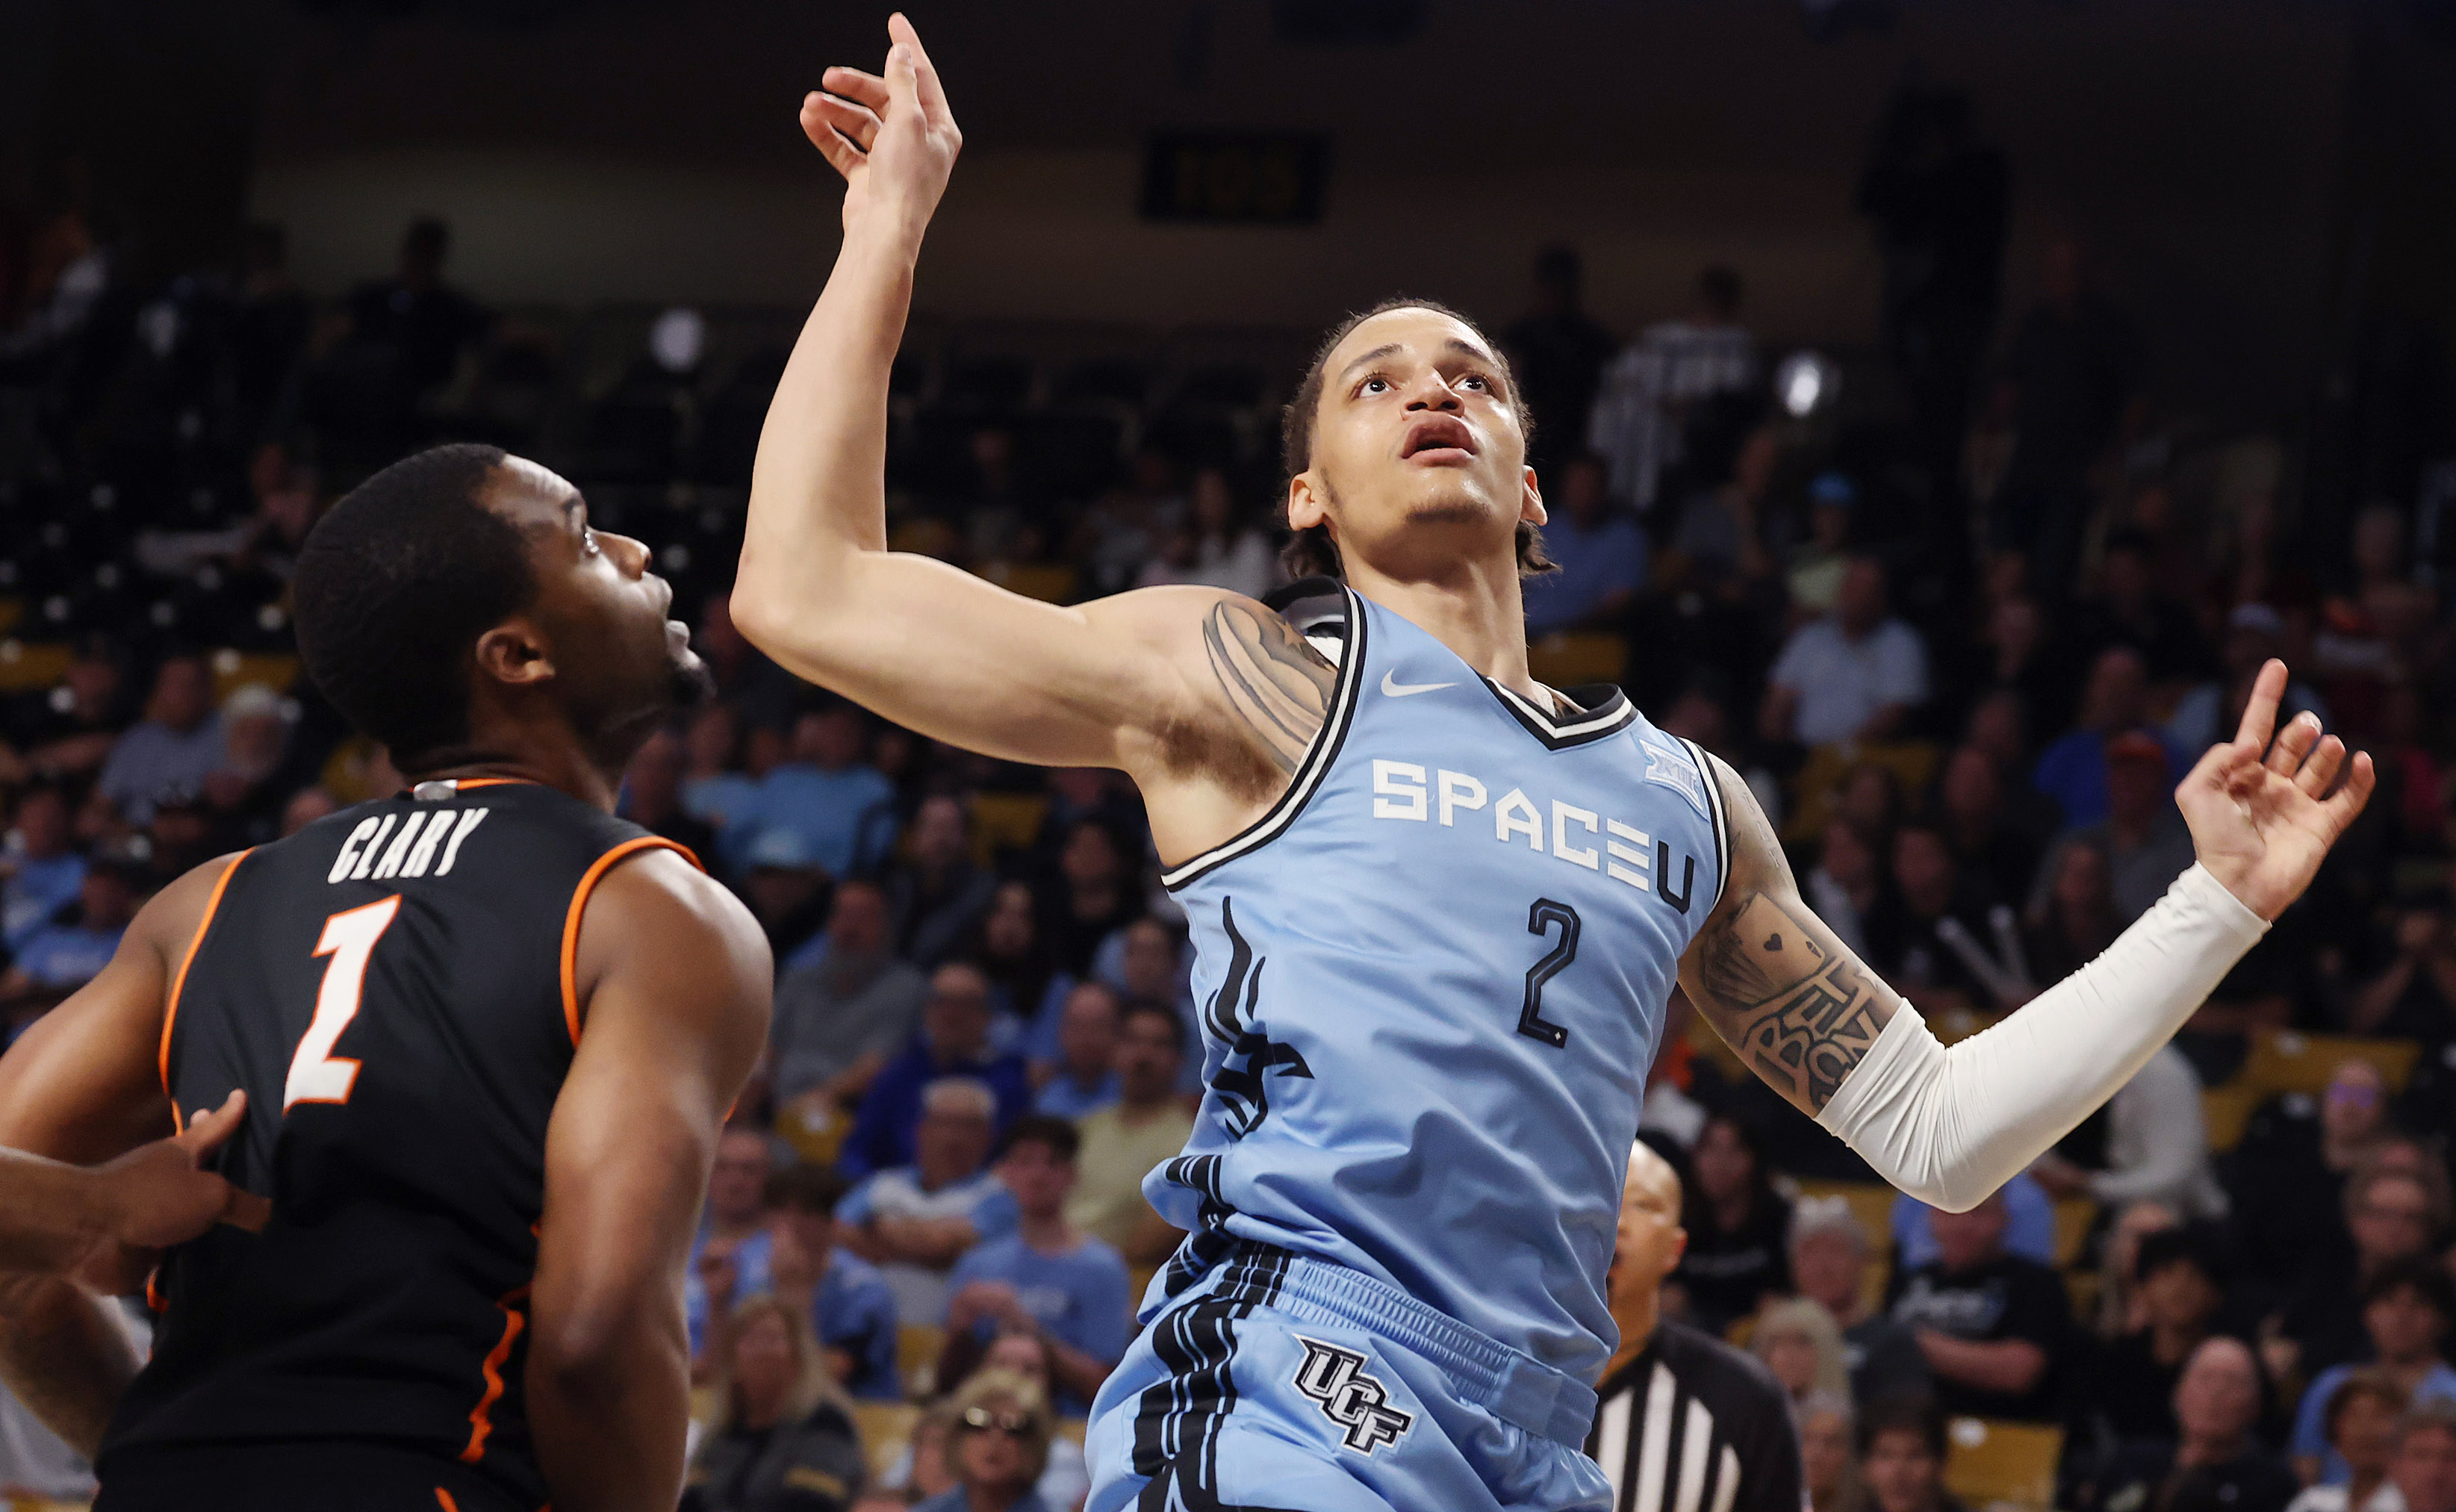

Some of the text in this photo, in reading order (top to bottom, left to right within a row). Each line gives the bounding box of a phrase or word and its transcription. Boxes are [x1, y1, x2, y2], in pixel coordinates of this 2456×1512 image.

[327, 806, 489, 884] CLARY
[283, 893, 402, 1115] 1
[1517, 897, 1581, 1049] 2
[1292, 1333, 1415, 1457] UCF
